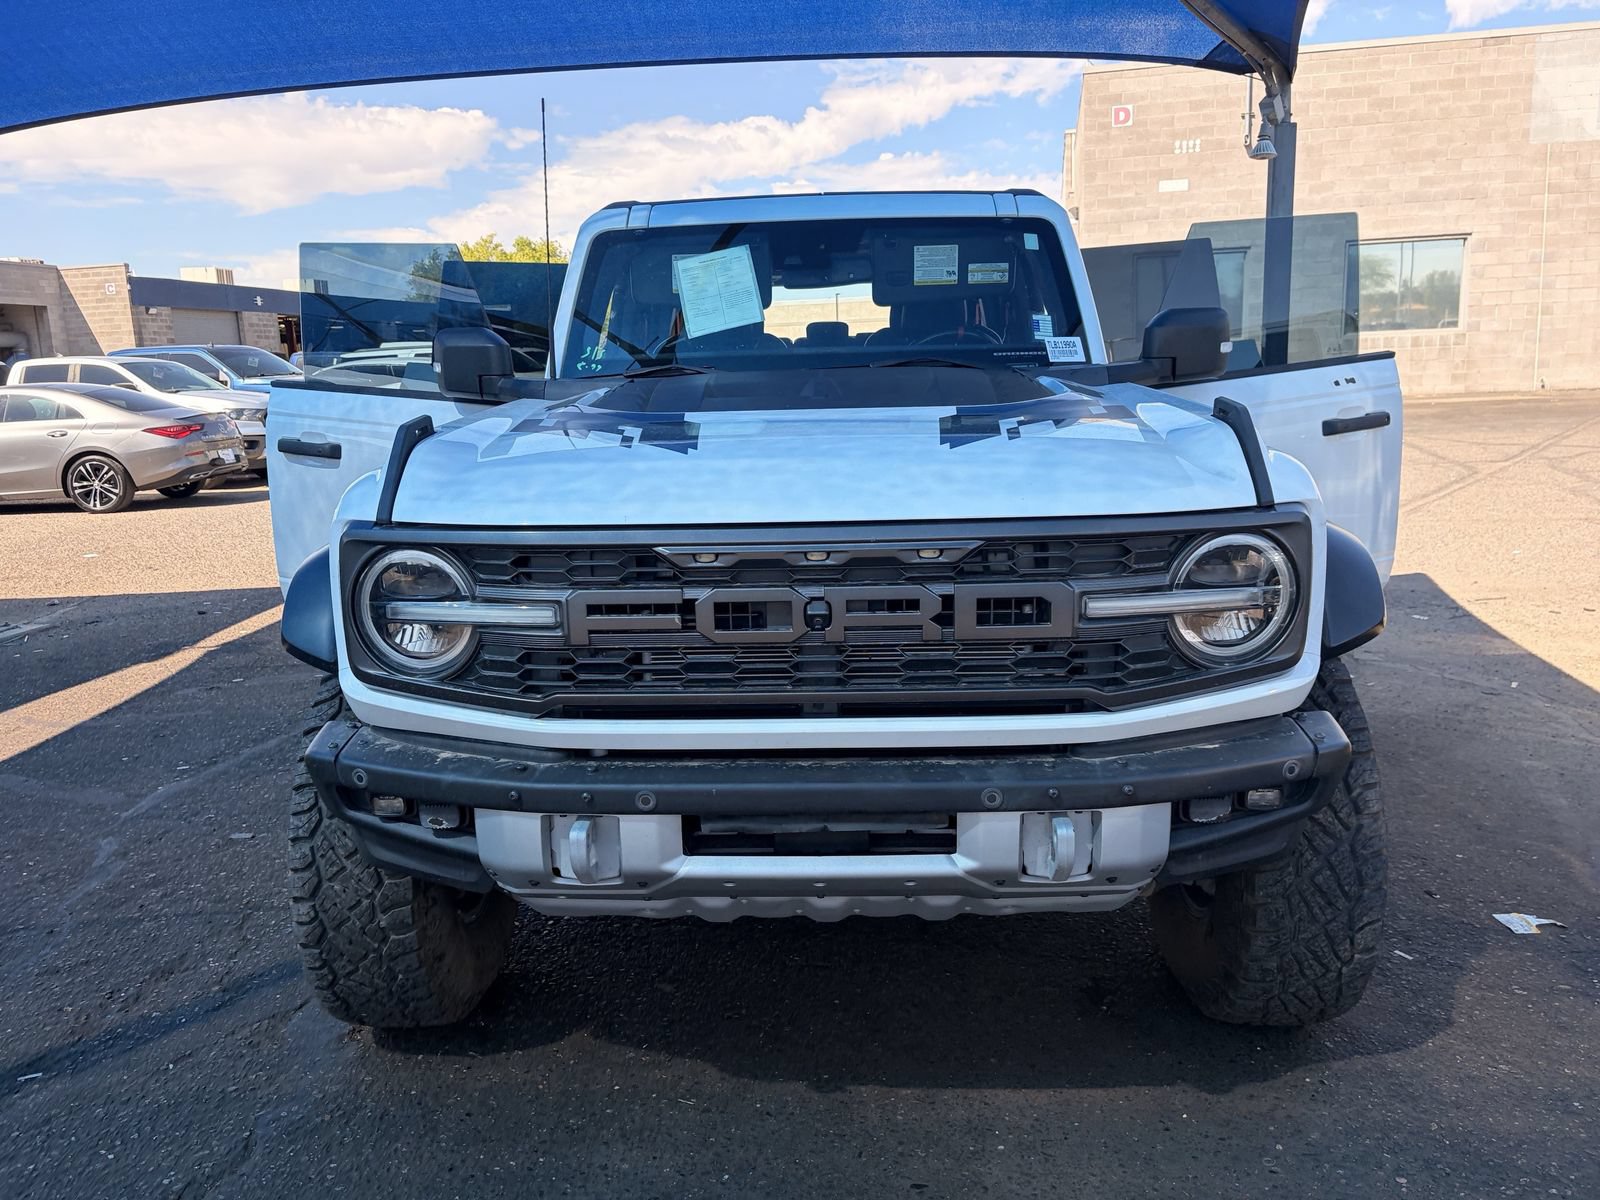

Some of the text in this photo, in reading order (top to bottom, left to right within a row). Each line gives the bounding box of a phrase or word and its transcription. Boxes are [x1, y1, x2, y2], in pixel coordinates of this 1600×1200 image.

[1113, 107, 1131, 126] D
[107, 284, 114, 293] C
[567, 583, 1075, 646] FORD
